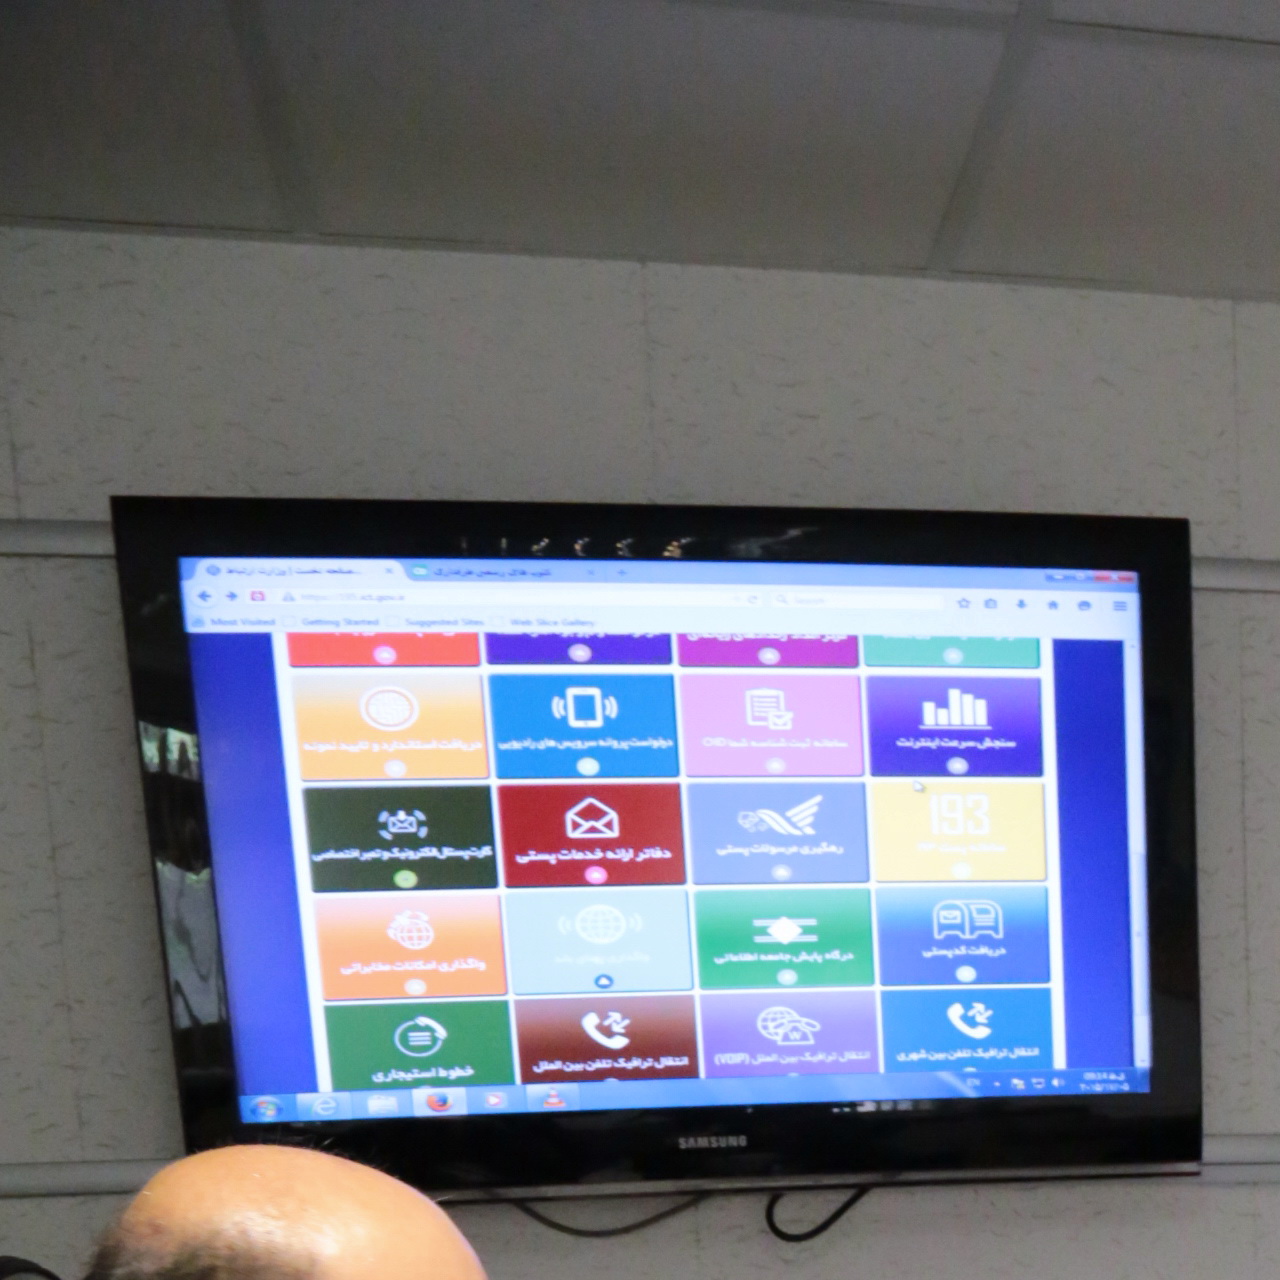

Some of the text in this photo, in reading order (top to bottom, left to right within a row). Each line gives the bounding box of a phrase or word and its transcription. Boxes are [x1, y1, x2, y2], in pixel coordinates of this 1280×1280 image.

[930, 793, 991, 836] 193
[515, 849, 558, 865] پستی
[557, 847, 604, 860] خدمات
[635, 846, 673, 862] دفاتر
[653, 1054, 690, 1070] انتقال
[437, 1064, 476, 1080] خطوط
[678, 1135, 748, 1149] SAMSUNG
